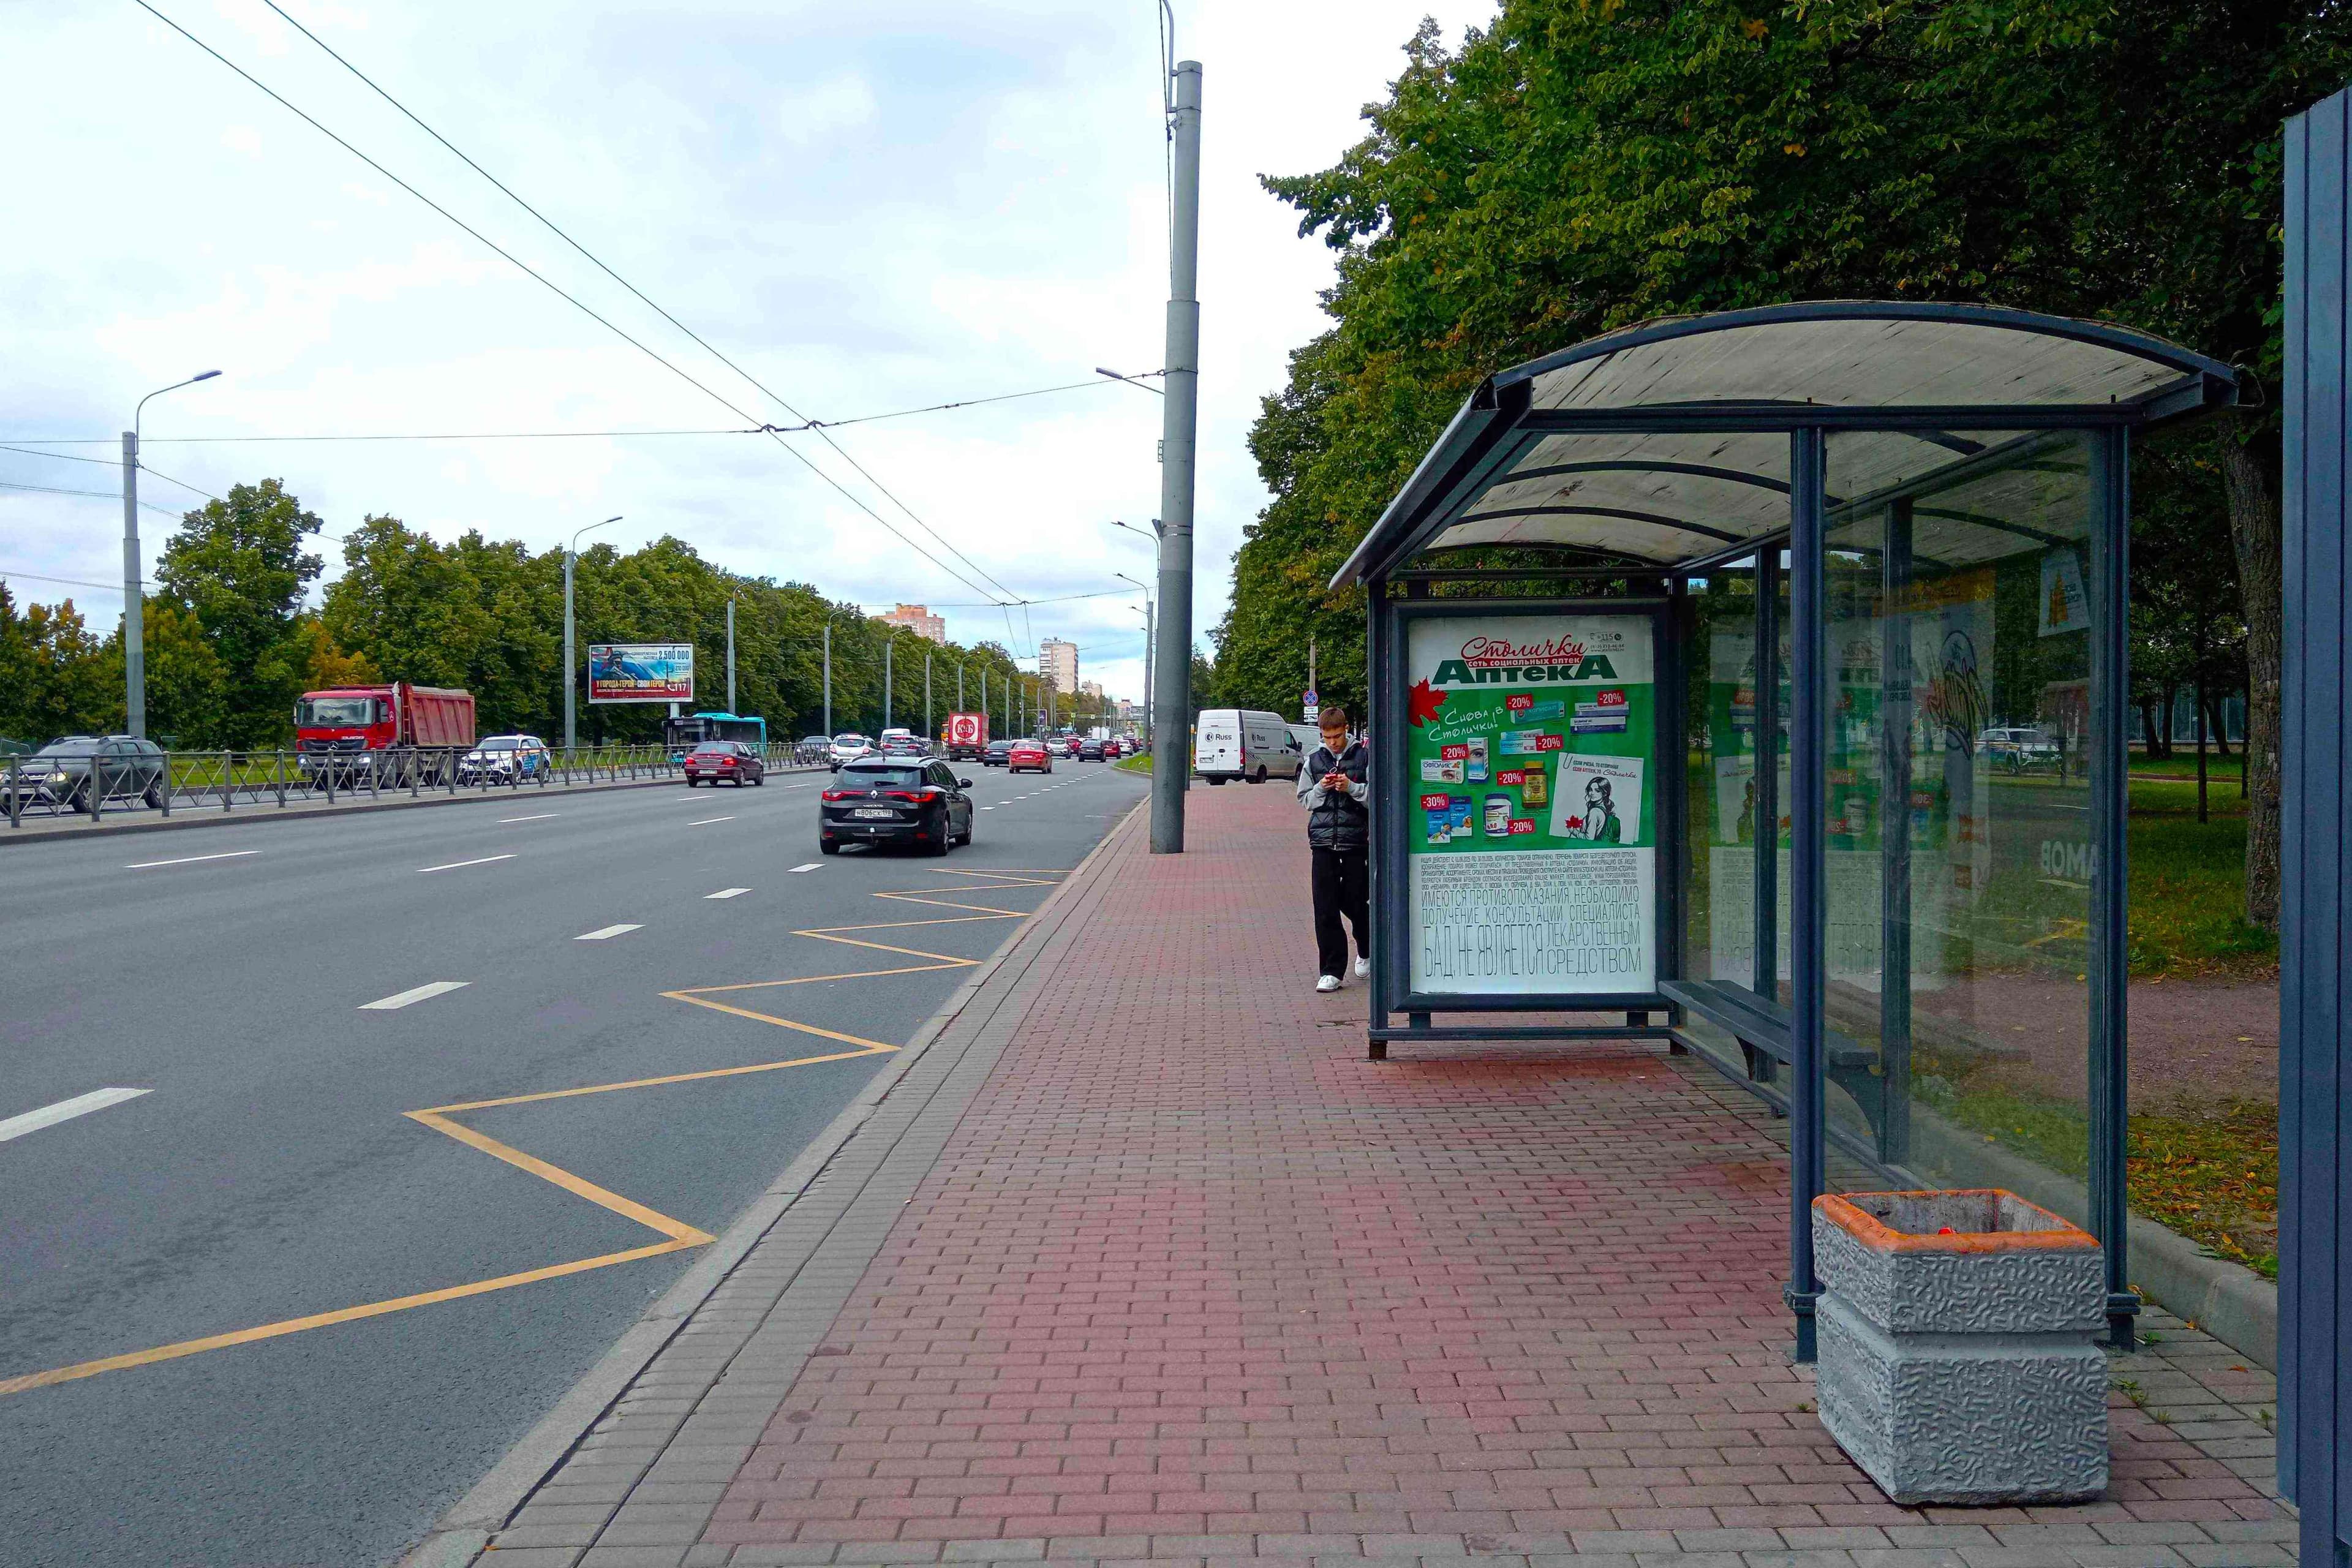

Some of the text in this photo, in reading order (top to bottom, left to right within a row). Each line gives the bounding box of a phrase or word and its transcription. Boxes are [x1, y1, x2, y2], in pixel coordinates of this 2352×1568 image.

[1461, 634, 1588, 659] Столички
[1490, 658, 1549, 668] социальных
[1552, 657, 1580, 665] аптек
[676, 683, 687, 692] 117
[1508, 697, 1530, 708] -20%
[1599, 693, 1621, 704] -20%
[1537, 737, 1561, 748] -20%
[1443, 747, 1466, 758] -20%
[1499, 773, 1521, 784] -20%
[1422, 796, 1445, 807] -30%
[1510, 821, 1532, 832] -20%
[1422, 885, 1640, 907] ИМЕЮТСЯ ПРОТИВОПОКАЗАНИЯ. НЕОБХОДИМО
[1422, 903, 1640, 925] ПОЛУЧЕНИЕ КОНСУЛЬТАЦИИ СПЕЦИАЛИСТА
[1458, 925, 1474, 976] НЕ
[1477, 923, 1544, 976] ЯВЛЯЕТСЯ
[1547, 921, 1640, 947] ЛЕКАРСТВЕННЫМ
[1547, 946, 1642, 976] СРЕДСТВОМ
